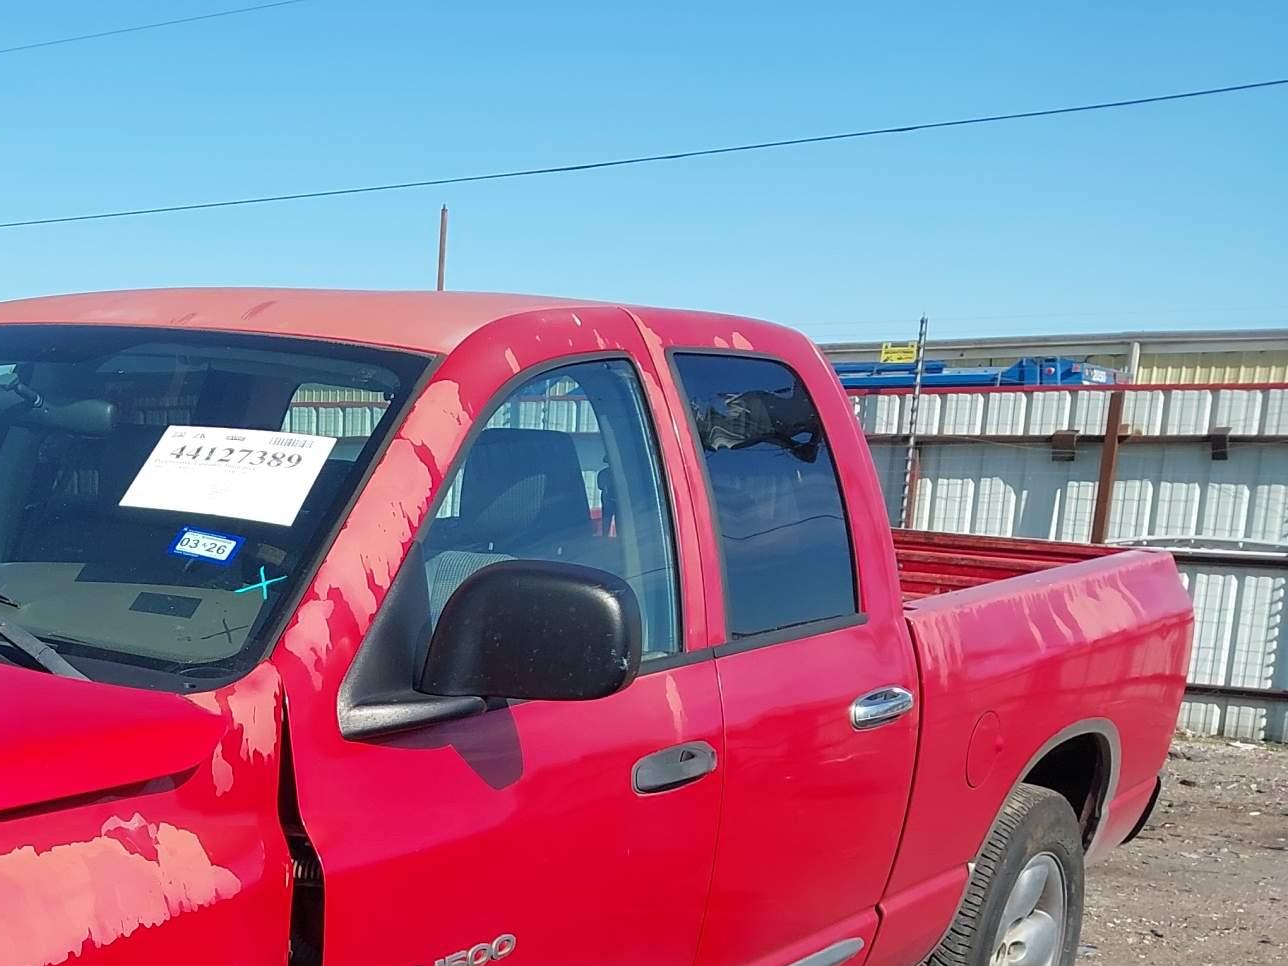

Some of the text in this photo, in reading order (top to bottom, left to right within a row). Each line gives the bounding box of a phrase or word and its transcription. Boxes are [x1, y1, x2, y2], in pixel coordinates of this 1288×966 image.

[169, 444, 304, 469] 44127389
[179, 537, 200, 549] 03
[205, 542, 228, 555] 26
